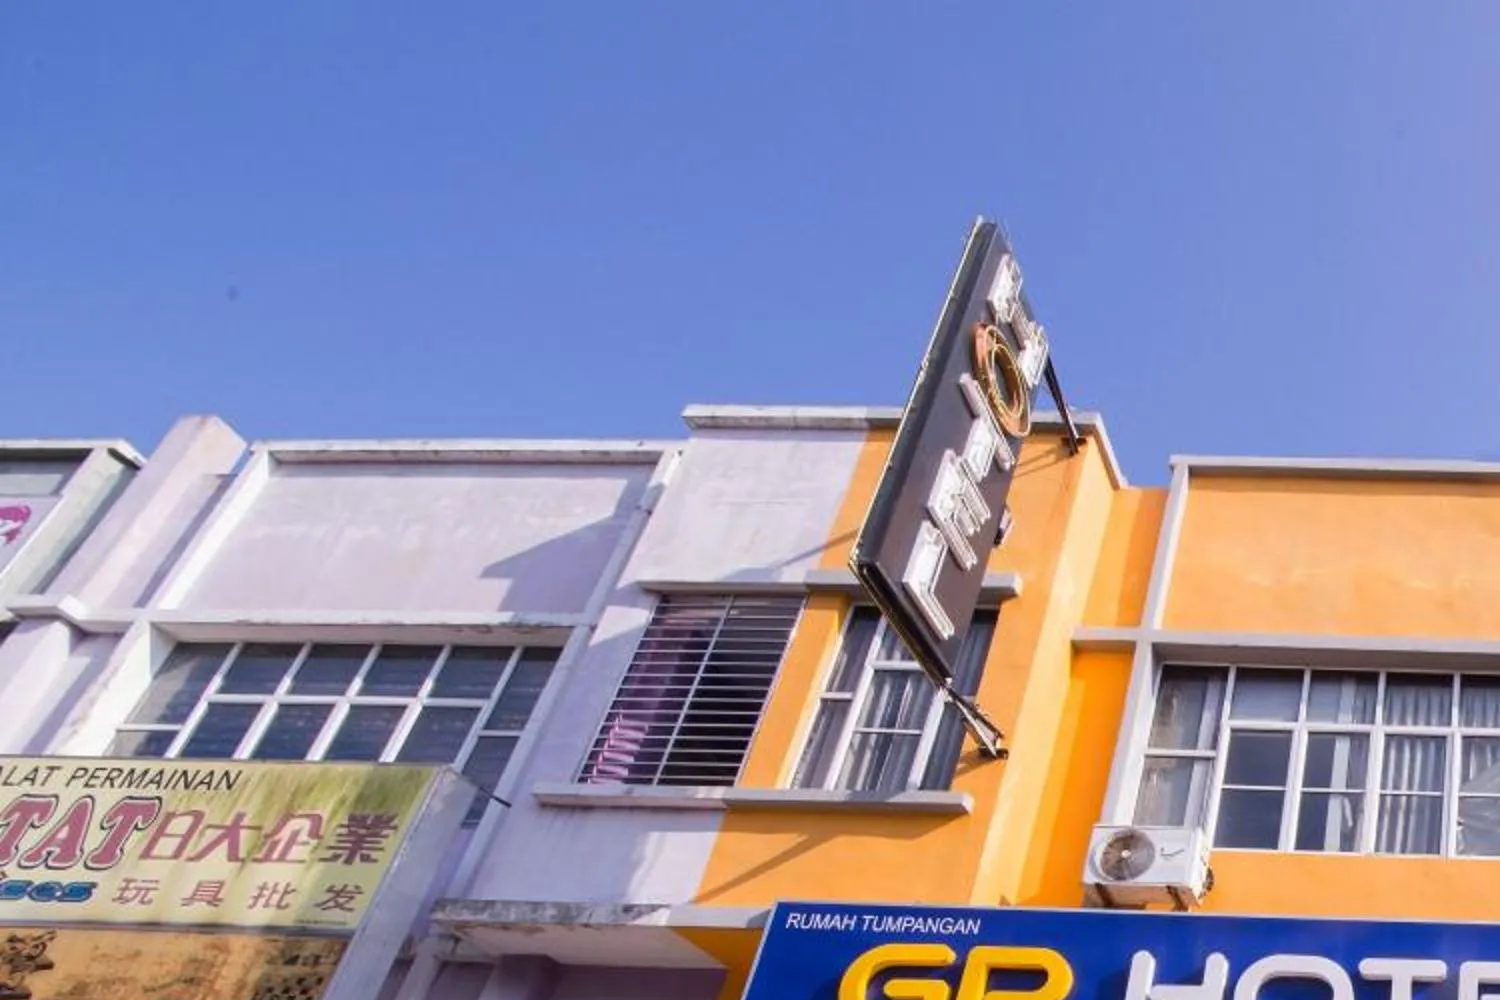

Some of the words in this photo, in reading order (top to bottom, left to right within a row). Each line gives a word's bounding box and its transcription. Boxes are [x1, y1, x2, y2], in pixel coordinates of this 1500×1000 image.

[65, 766, 243, 791] PERMAINAN
[139, 809, 399, 866] 日大企業
[785, 911, 857, 932] RUMAH
[860, 914, 981, 935] TUMPANGAN
